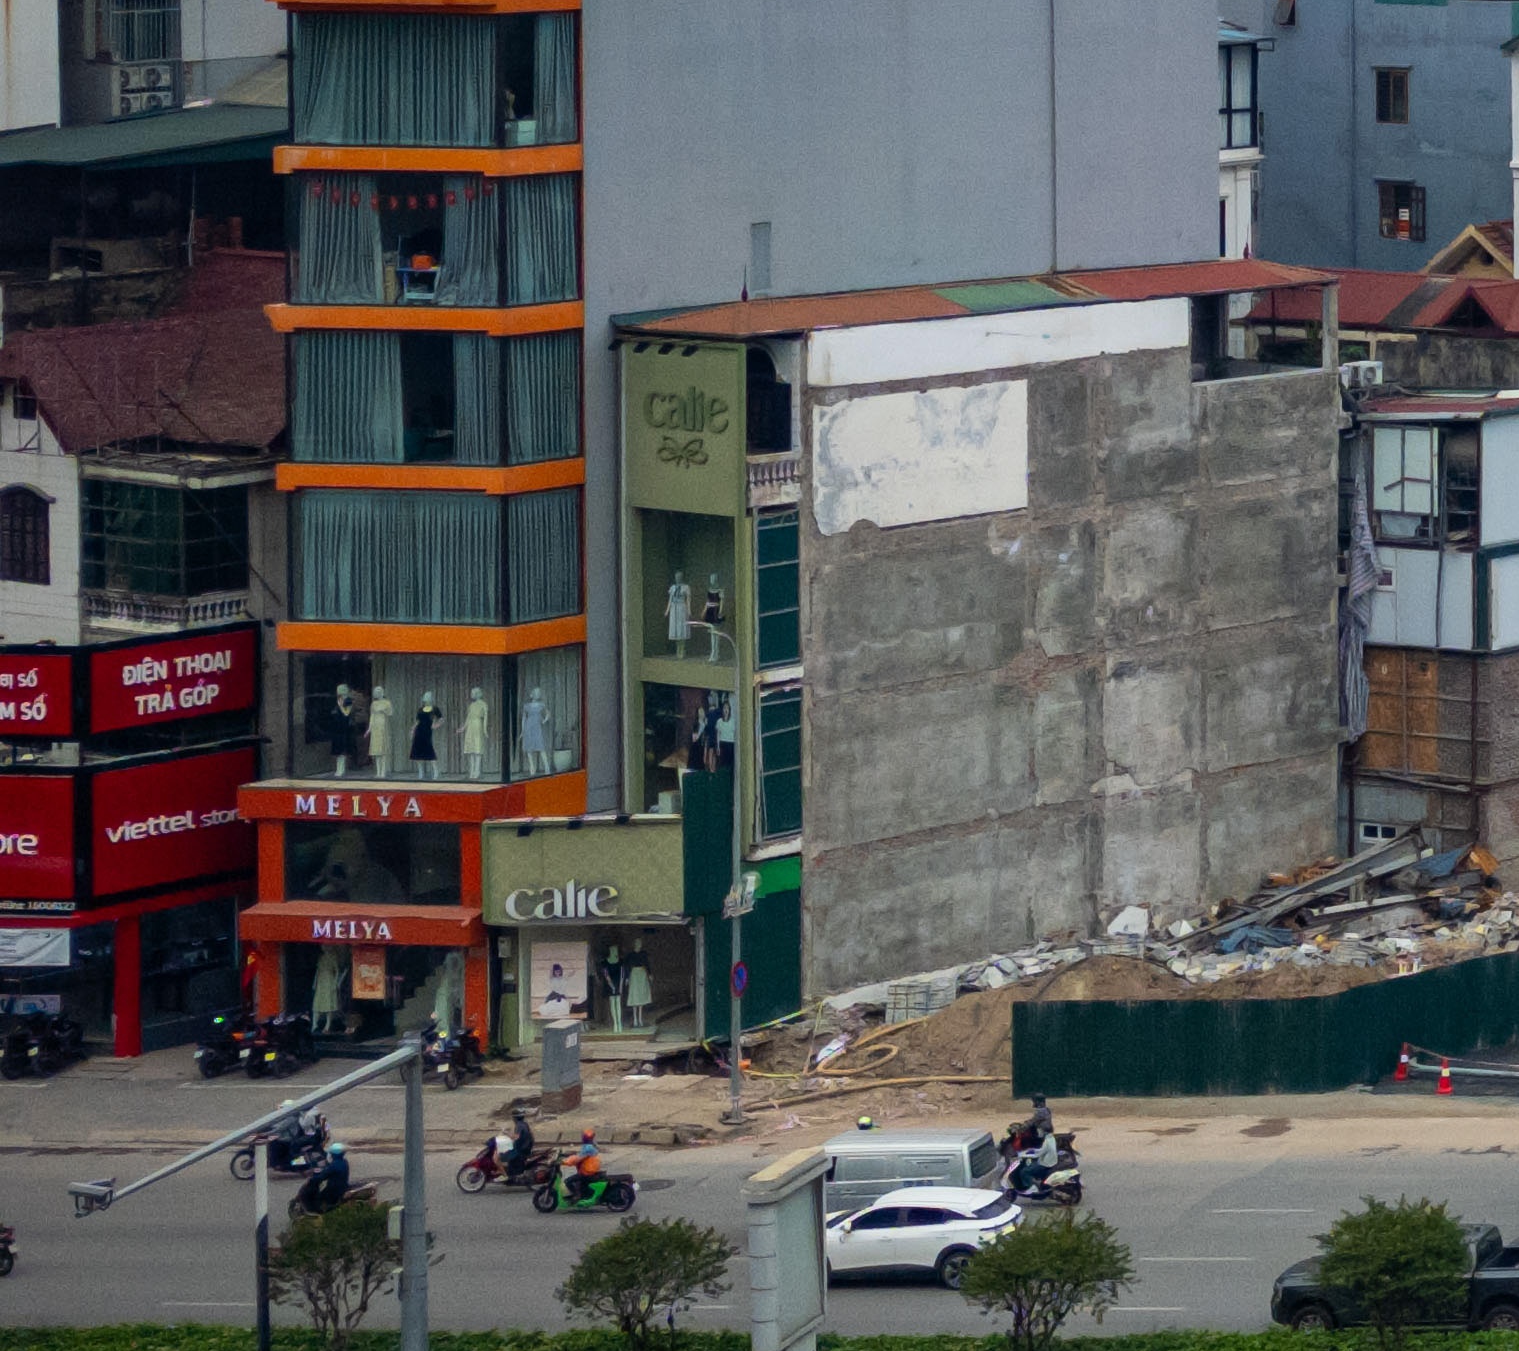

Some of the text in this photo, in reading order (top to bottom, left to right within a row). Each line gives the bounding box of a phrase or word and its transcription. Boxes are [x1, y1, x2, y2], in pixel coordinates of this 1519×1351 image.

[122, 650, 232, 686] ĐIỆN THOẠI
[134, 678, 219, 716] TRẢ GÓP
[294, 794, 423, 818] MELYA
[105, 808, 250, 843] viettel stor
[505, 878, 619, 921] calie
[311, 918, 393, 941] MELYA
